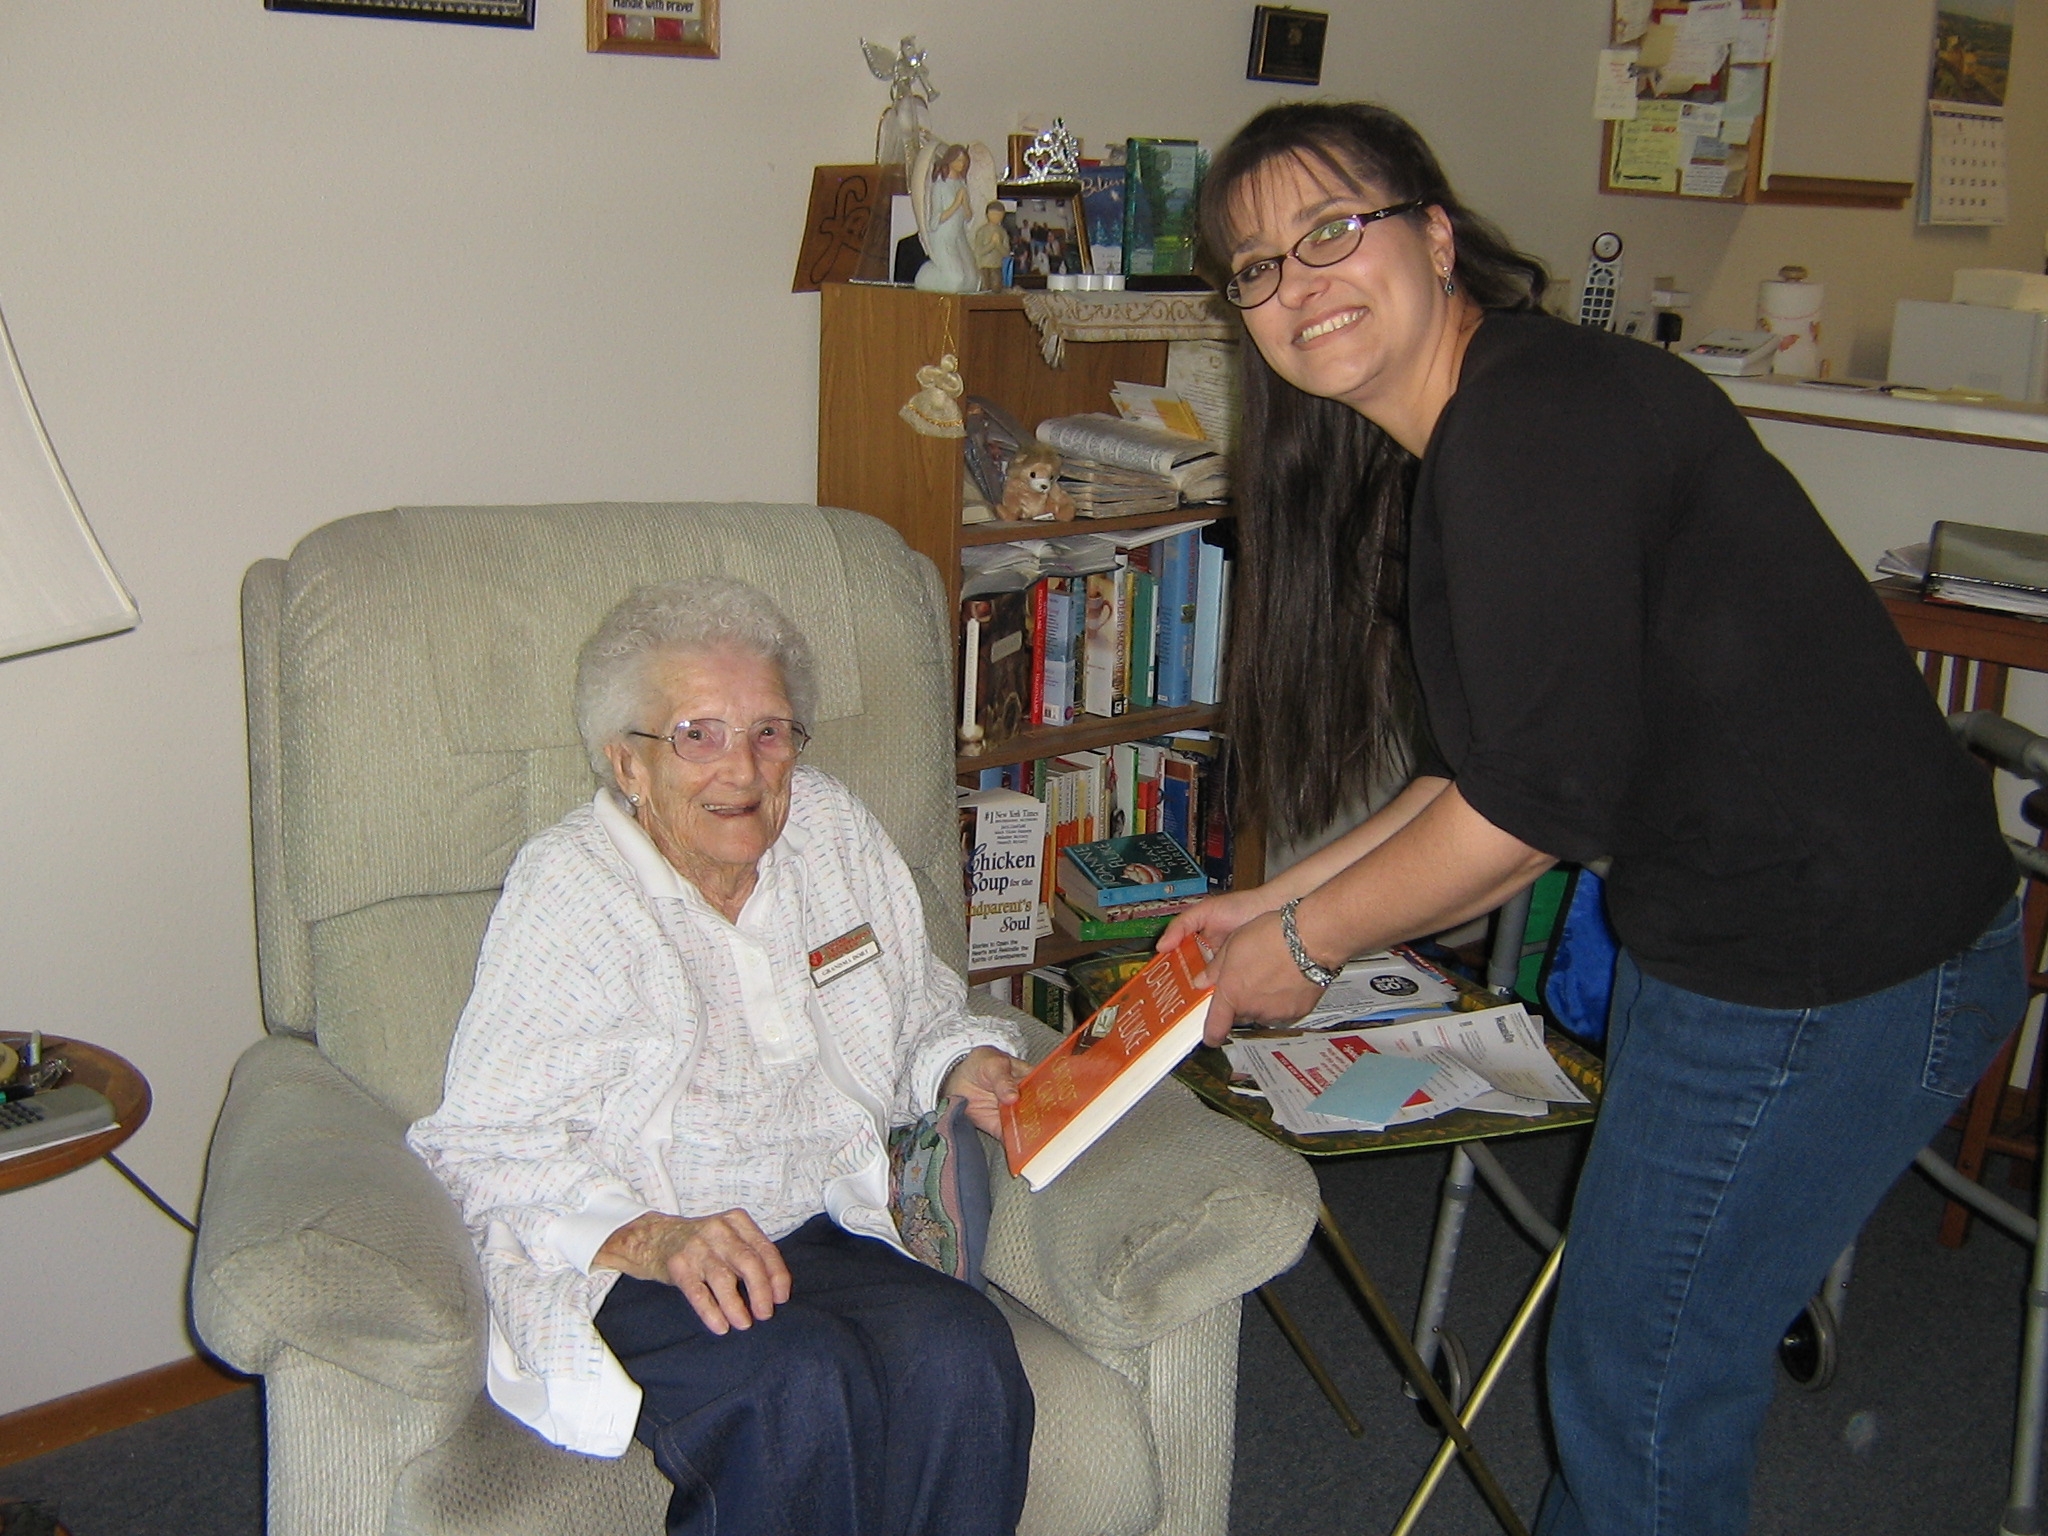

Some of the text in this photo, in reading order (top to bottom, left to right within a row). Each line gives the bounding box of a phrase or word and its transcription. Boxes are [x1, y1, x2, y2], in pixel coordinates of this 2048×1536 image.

[645, 0, 664, 11] with
[666, 0, 694, 13] prayer
[1080, 175, 1126, 198] Believ
[984, 811, 994, 824] #1
[995, 811, 1007, 819] New
[1009, 810, 1021, 818] York
[1022, 809, 1039, 817] Times
[966, 842, 1036, 873] Chicken
[1074, 846, 1121, 887] JOANNE
[1097, 842, 1127, 869] FLUKE
[1139, 840, 1172, 874] CREAM
[1153, 844, 1178, 867] PUFF
[1160, 834, 1198, 876] MURDER
[964, 871, 1033, 897] Soup for the
[965, 898, 1032, 919] ndparent's
[999, 916, 1031, 933] Soul
[1142, 952, 1186, 1024] JOANNE
[1117, 999, 1151, 1056] FLUKE
[1036, 1080, 1058, 1118] CAKE
